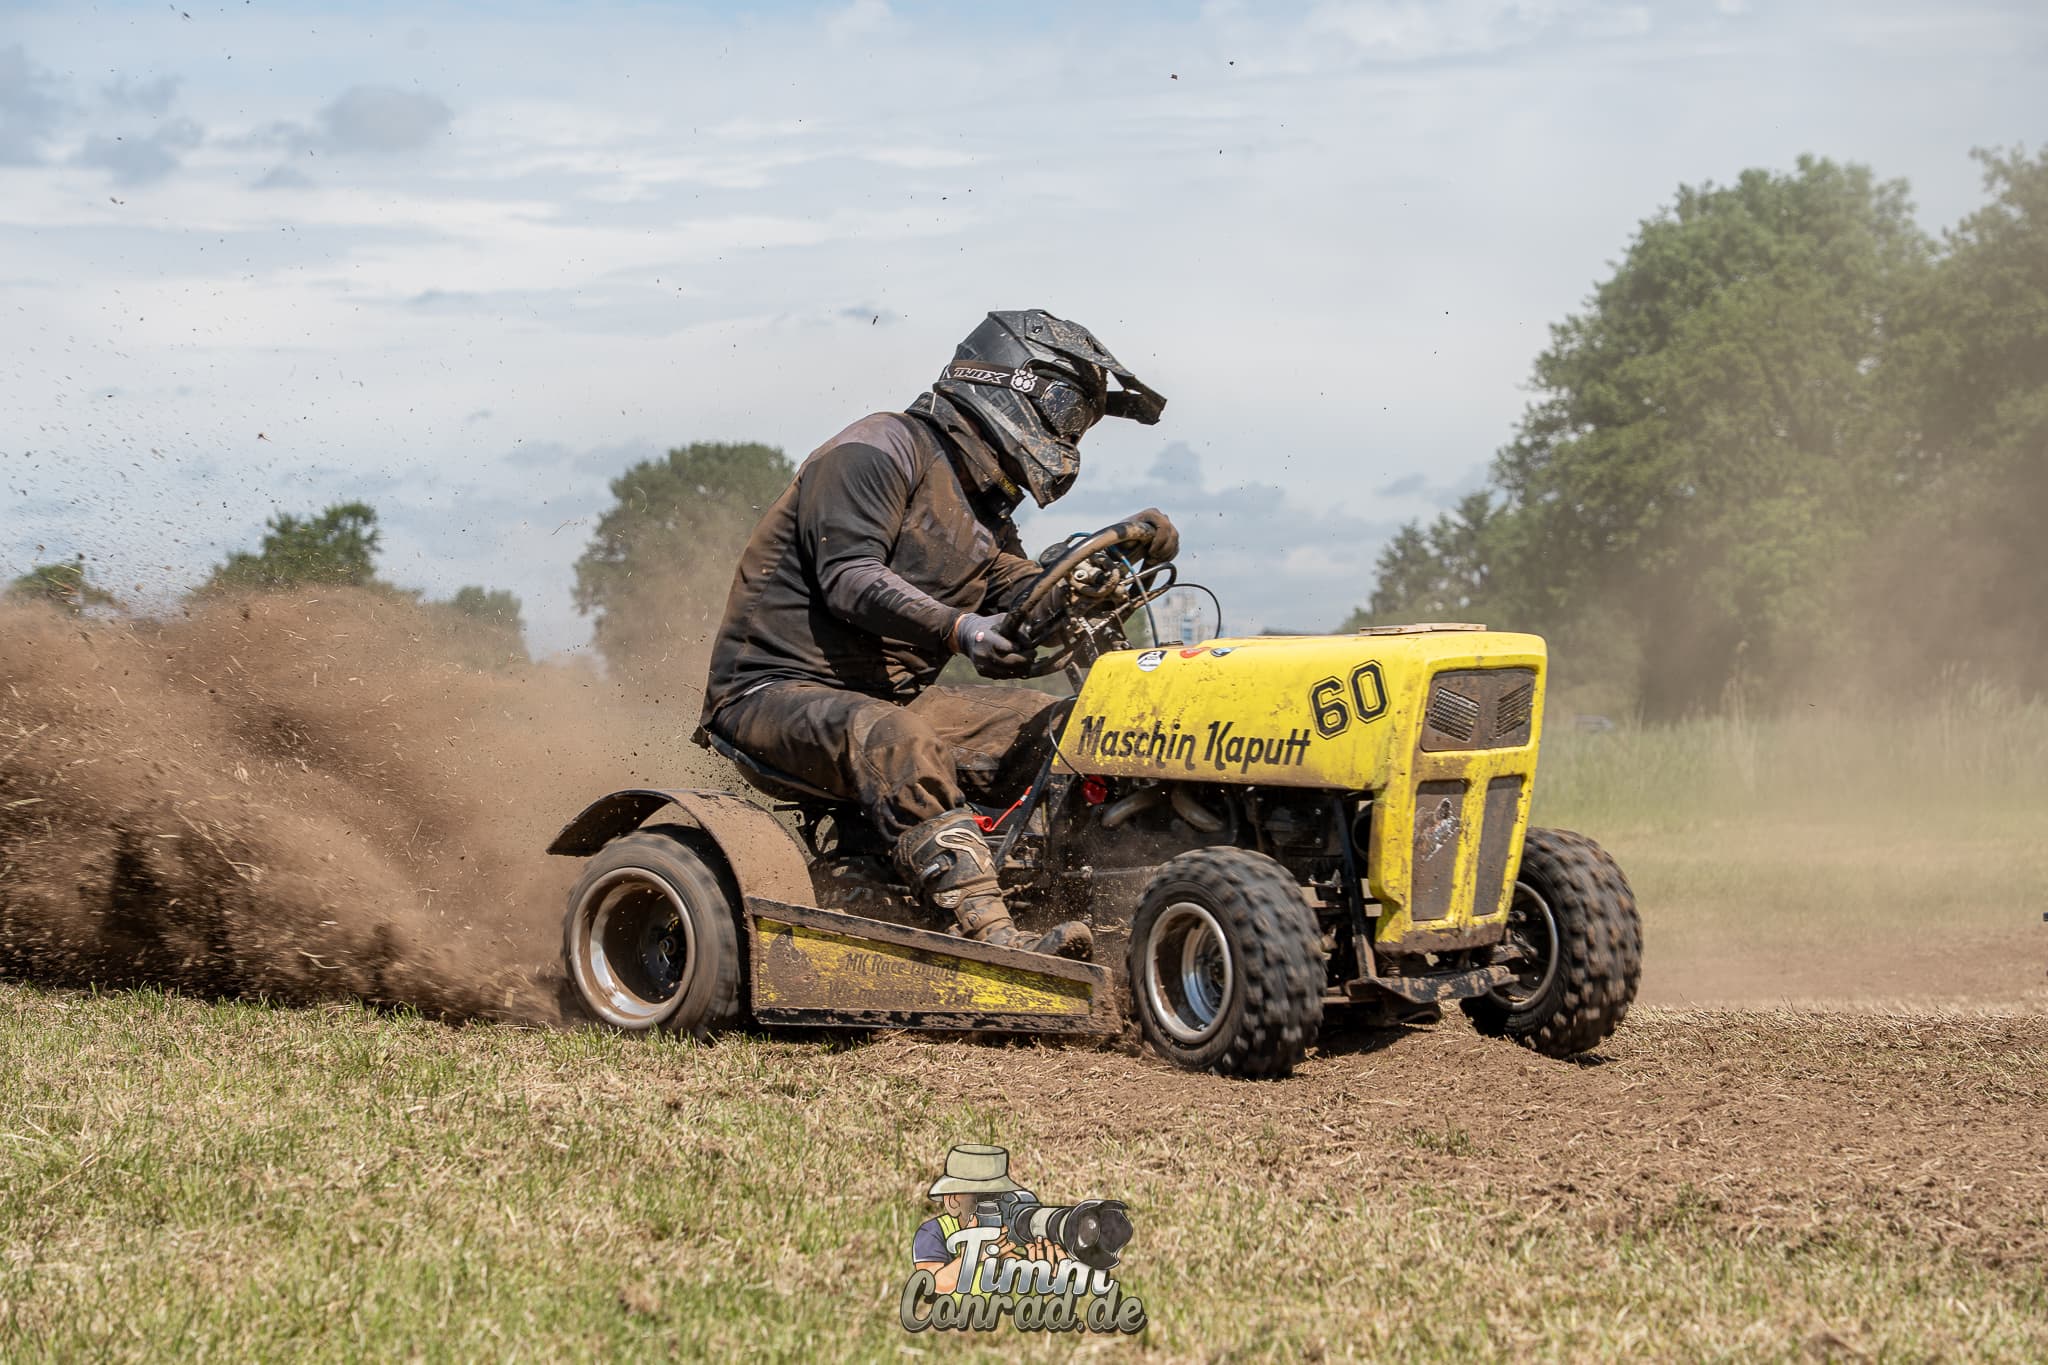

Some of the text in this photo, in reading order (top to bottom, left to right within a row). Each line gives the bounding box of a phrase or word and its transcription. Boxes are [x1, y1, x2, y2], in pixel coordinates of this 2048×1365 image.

[1308, 659, 1391, 740] 60
[1077, 715, 1311, 774] Maschin Kaputt
